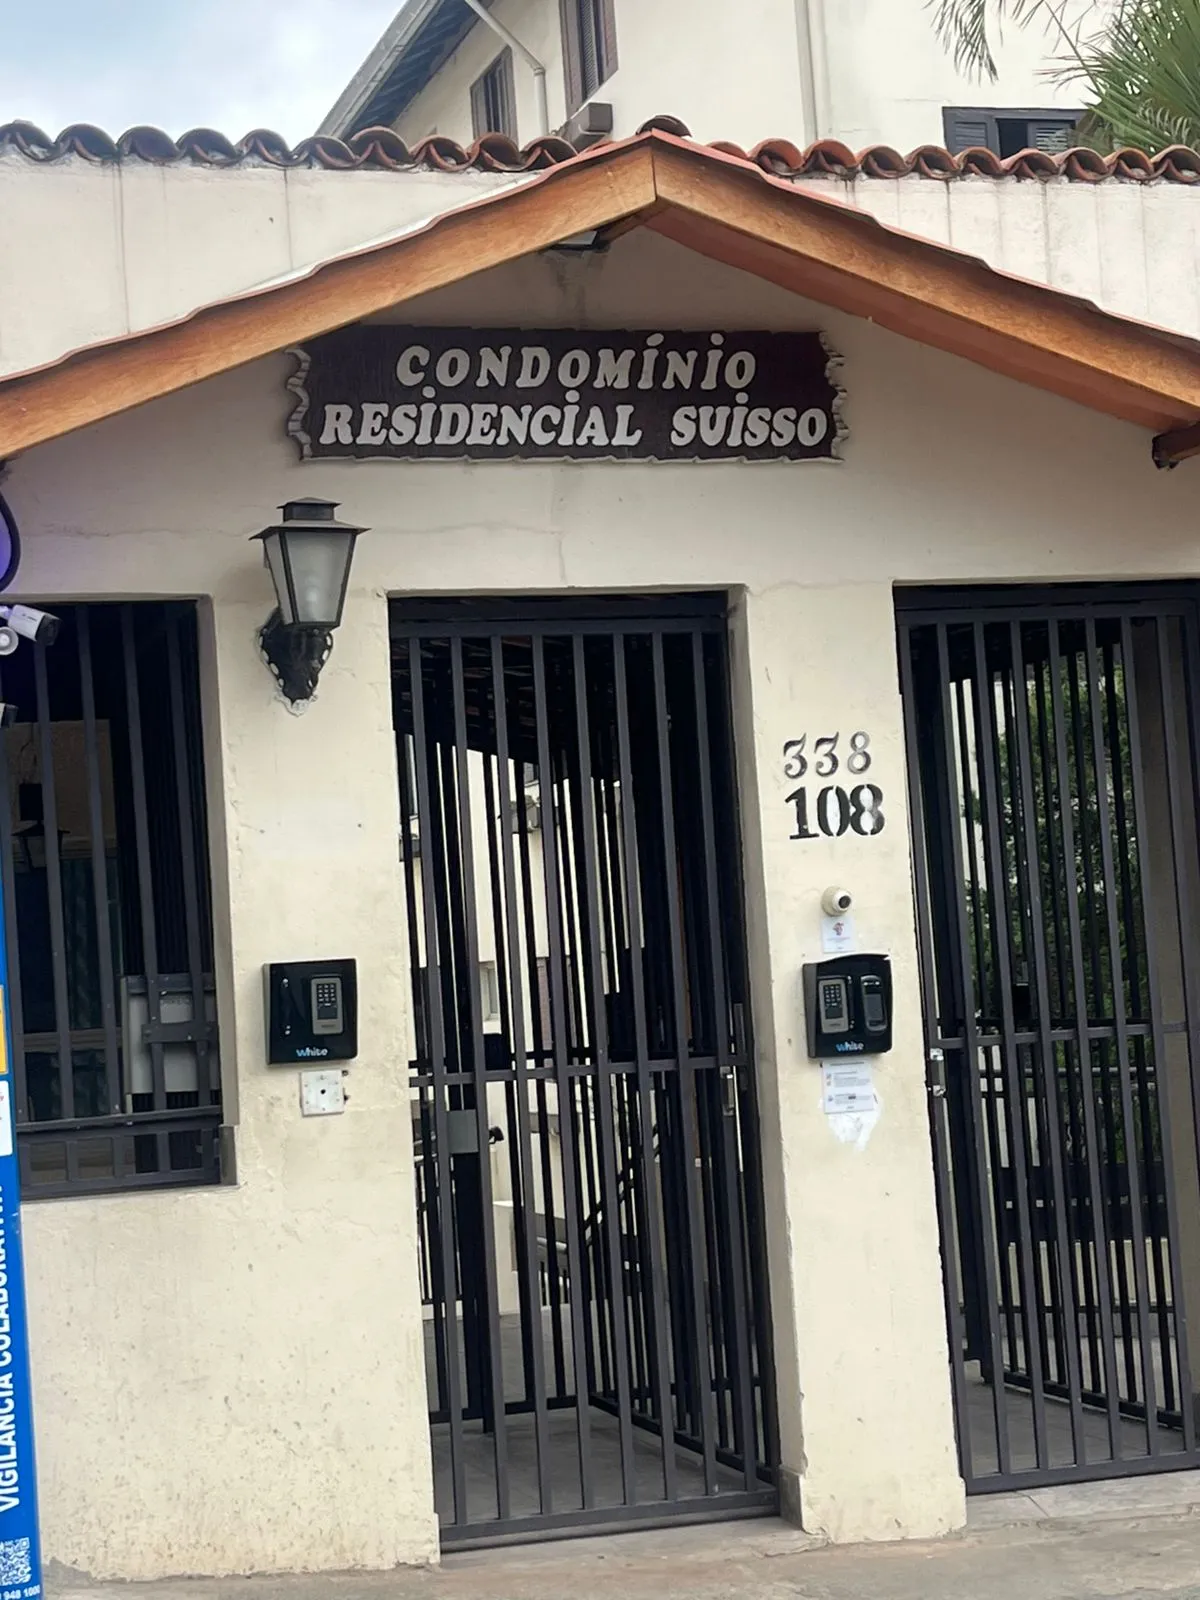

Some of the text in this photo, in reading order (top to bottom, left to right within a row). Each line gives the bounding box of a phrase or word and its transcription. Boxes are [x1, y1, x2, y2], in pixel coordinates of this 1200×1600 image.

[396, 333, 756, 390] CONDOMÍNIO
[319, 386, 827, 447] RESIDENCIAL SUISSO
[783, 731, 872, 779] 338
[784, 784, 885, 839] 108
